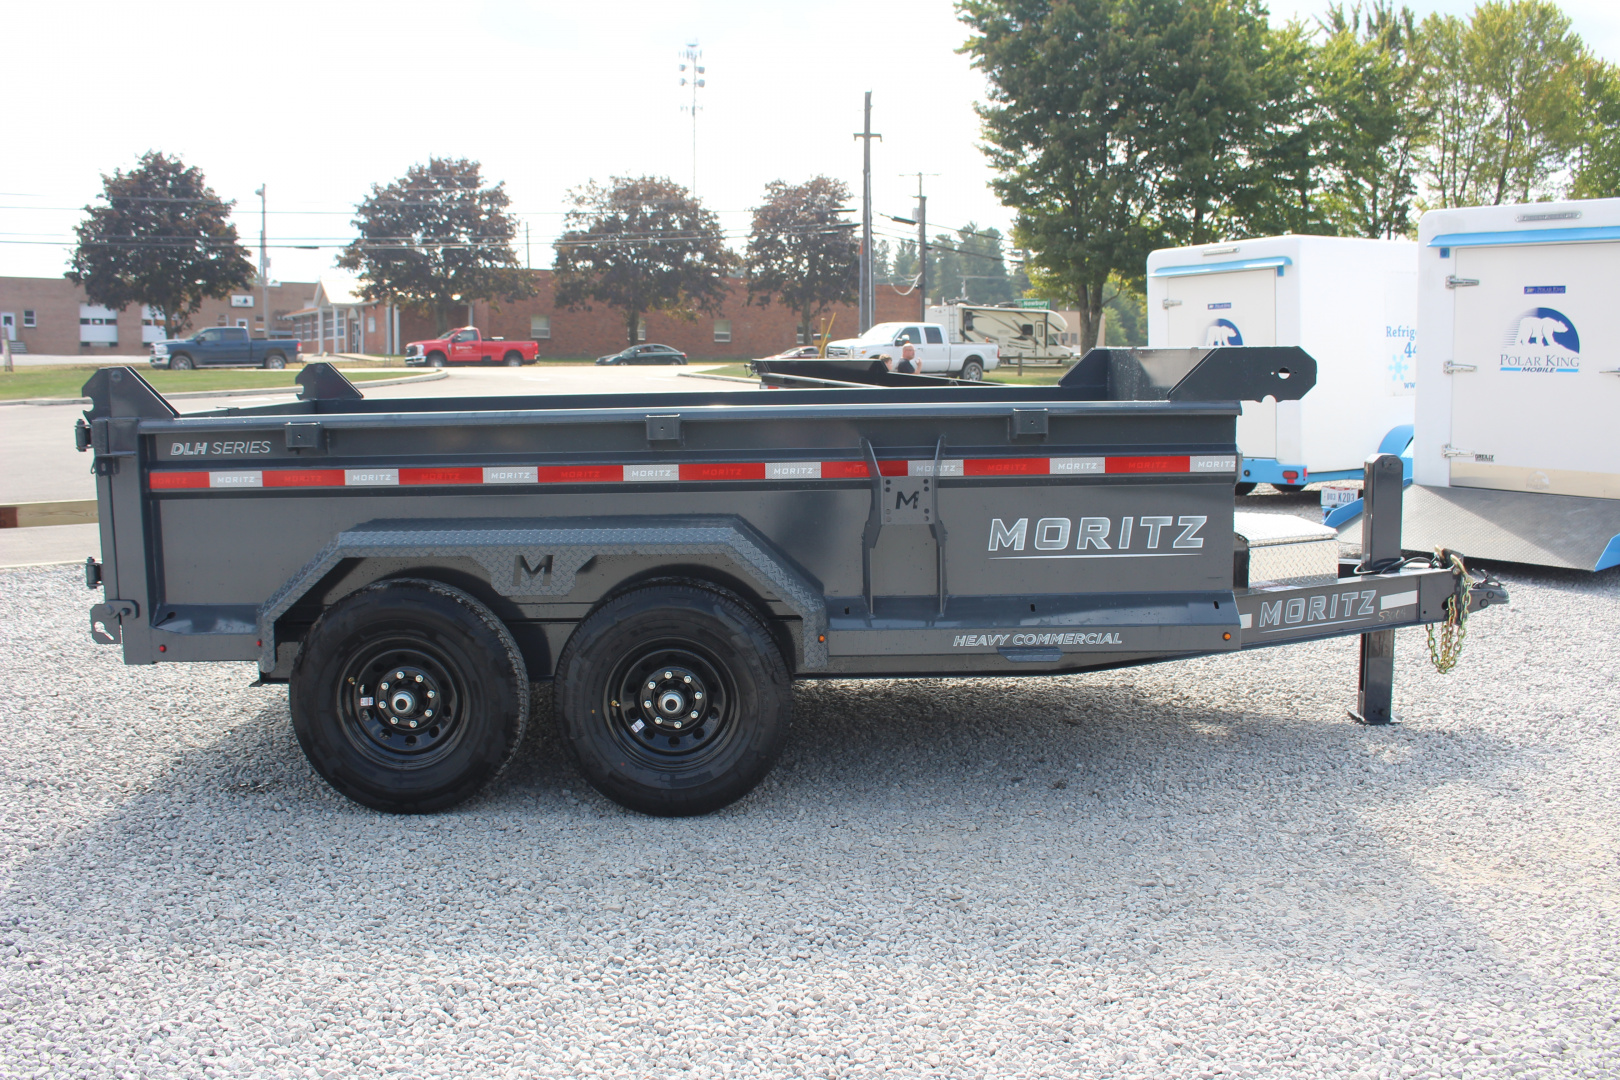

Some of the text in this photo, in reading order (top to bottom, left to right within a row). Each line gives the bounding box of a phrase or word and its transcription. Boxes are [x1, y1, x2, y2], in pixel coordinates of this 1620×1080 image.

[1386, 325, 1417, 341] Refrig
[1545, 354, 1580, 368] KING
[170, 441, 272, 456] DLH SERIES
[217, 476, 255, 484] MORITZ
[284, 475, 322, 483] MORITZ
[352, 474, 391, 482] MORITZ
[421, 473, 460, 481] MORITZ
[491, 472, 530, 480] MORITZ
[773, 467, 813, 475] MORITZ
[987, 463, 1028, 471] MORITZ
[1057, 462, 1097, 470] MORITZ
[895, 490, 919, 510] M
[988, 515, 1208, 552] MORITZ
[511, 554, 554, 587] M
[1258, 589, 1377, 628] MORITZ
[952, 632, 1123, 647] HEAVY COMMERCIAL
